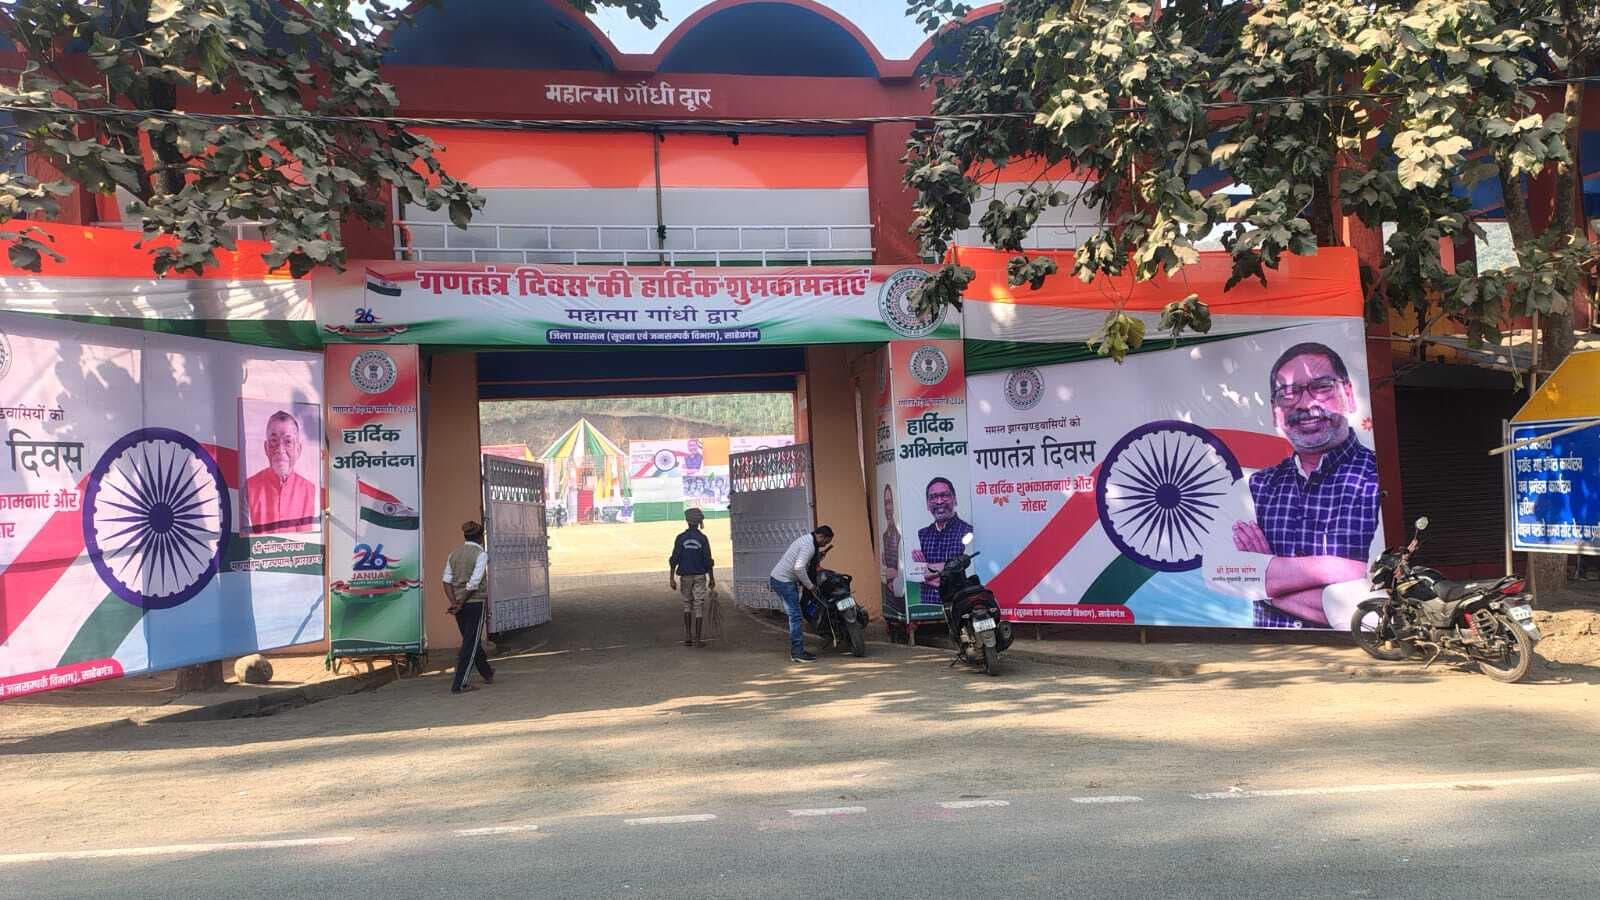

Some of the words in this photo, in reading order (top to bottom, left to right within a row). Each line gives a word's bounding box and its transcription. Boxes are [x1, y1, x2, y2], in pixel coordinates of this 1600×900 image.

[544, 84, 619, 104] महात्मा
[415, 265, 511, 297] गणतंत्र
[515, 267, 589, 298] दिवस
[594, 269, 634, 298] की
[638, 270, 719, 298] हार्दिक
[723, 268, 871, 305] शुभकामनाएं
[353, 308, 376, 324] 26
[565, 308, 638, 323] महात्मा
[645, 305, 698, 323] गांधी
[706, 309, 743, 325] द्वार
[549, 330, 571, 341] जिला
[48, 404, 64, 421] को
[1069, 416, 1080, 427] को
[906, 412, 955, 435] हार्दिक
[343, 424, 401, 444] हार्दिक
[6, 428, 84, 477] दिवस
[899, 437, 968, 459] अभिनंदन
[973, 439, 1035, 469] गणतंत्र
[1041, 435, 1096, 469] दिवस
[333, 451, 416, 469] अभिनंदन
[976, 481, 987, 495] की
[988, 479, 1015, 494] हार्दिक
[1016, 477, 1071, 496] शुभकामनाएं
[1074, 476, 1093, 490] और
[54, 488, 78, 508] और
[1021, 498, 1047, 511] जोहार
[0, 522, 16, 538] ार
[353, 543, 387, 571] 26
[352, 571, 395, 580] JANUAR
